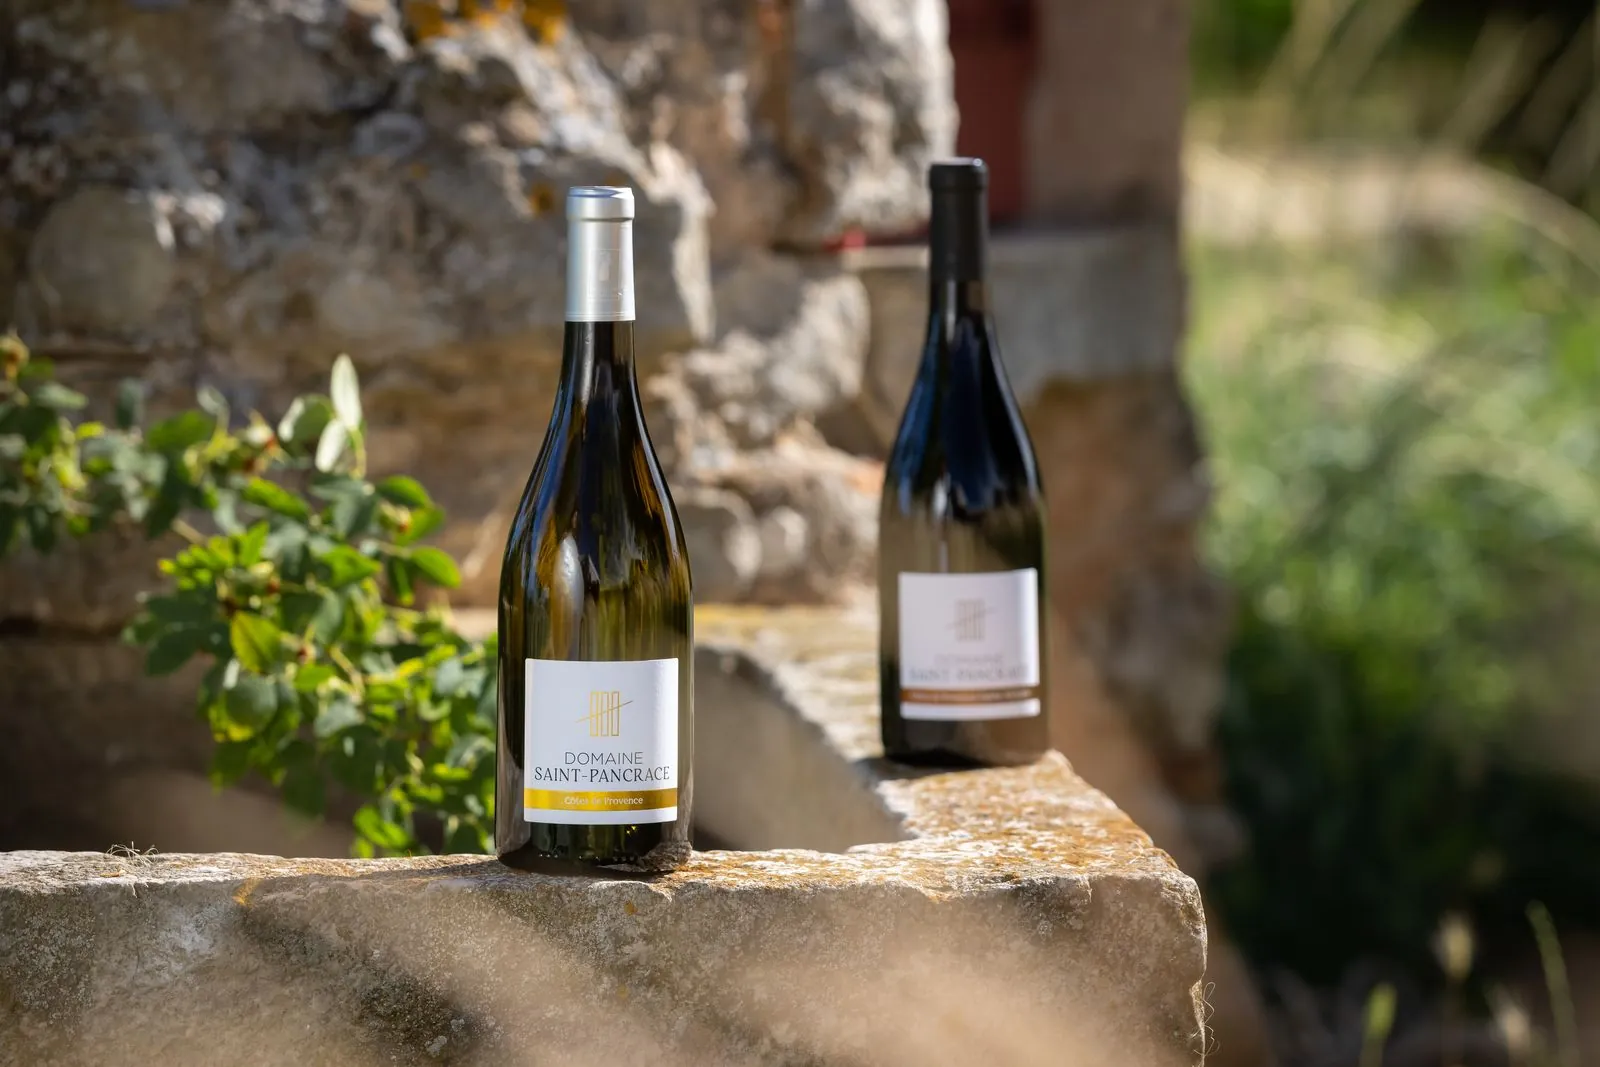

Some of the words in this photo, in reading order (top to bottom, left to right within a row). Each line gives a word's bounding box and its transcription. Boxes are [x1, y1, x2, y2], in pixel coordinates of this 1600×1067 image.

[565, 751, 643, 765] DOMAINE
[534, 766, 670, 782] SAINT-PANCRACE
[604, 796, 643, 805] Provence
